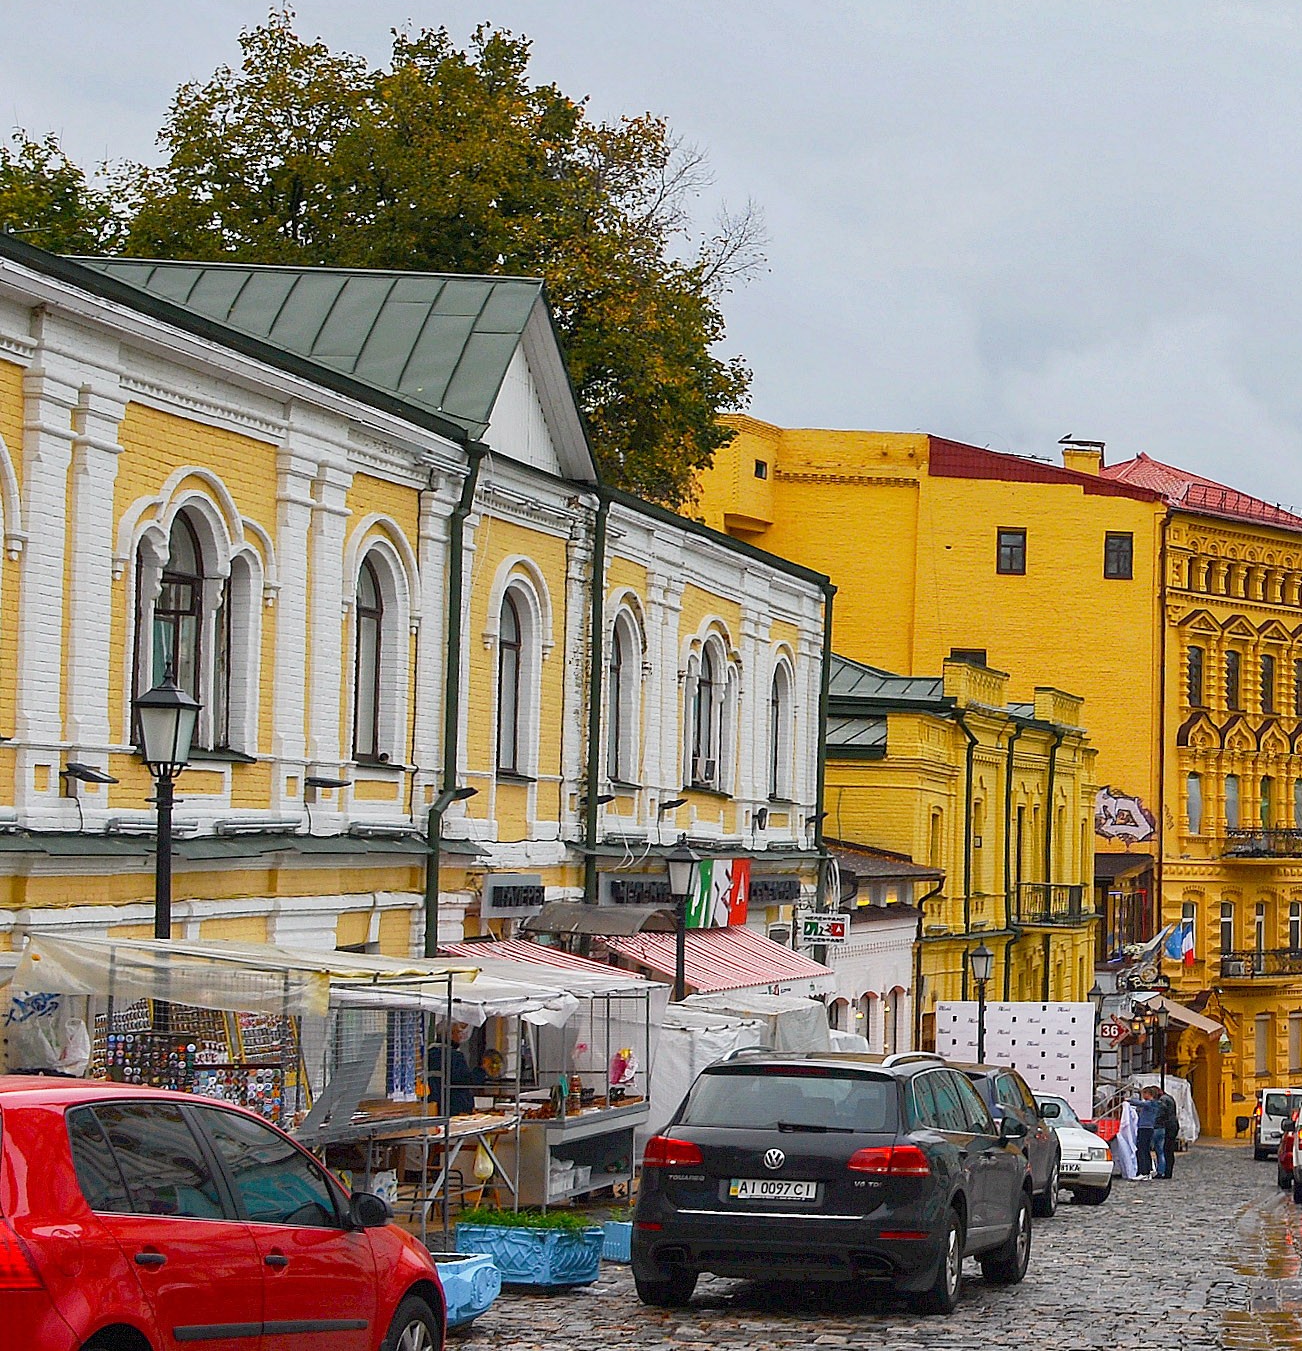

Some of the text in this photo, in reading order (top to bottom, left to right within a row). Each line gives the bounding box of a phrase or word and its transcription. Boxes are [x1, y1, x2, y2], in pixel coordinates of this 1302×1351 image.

[1102, 1025, 1119, 1037] 36
[739, 1181, 811, 1197] AI 0097 CI
